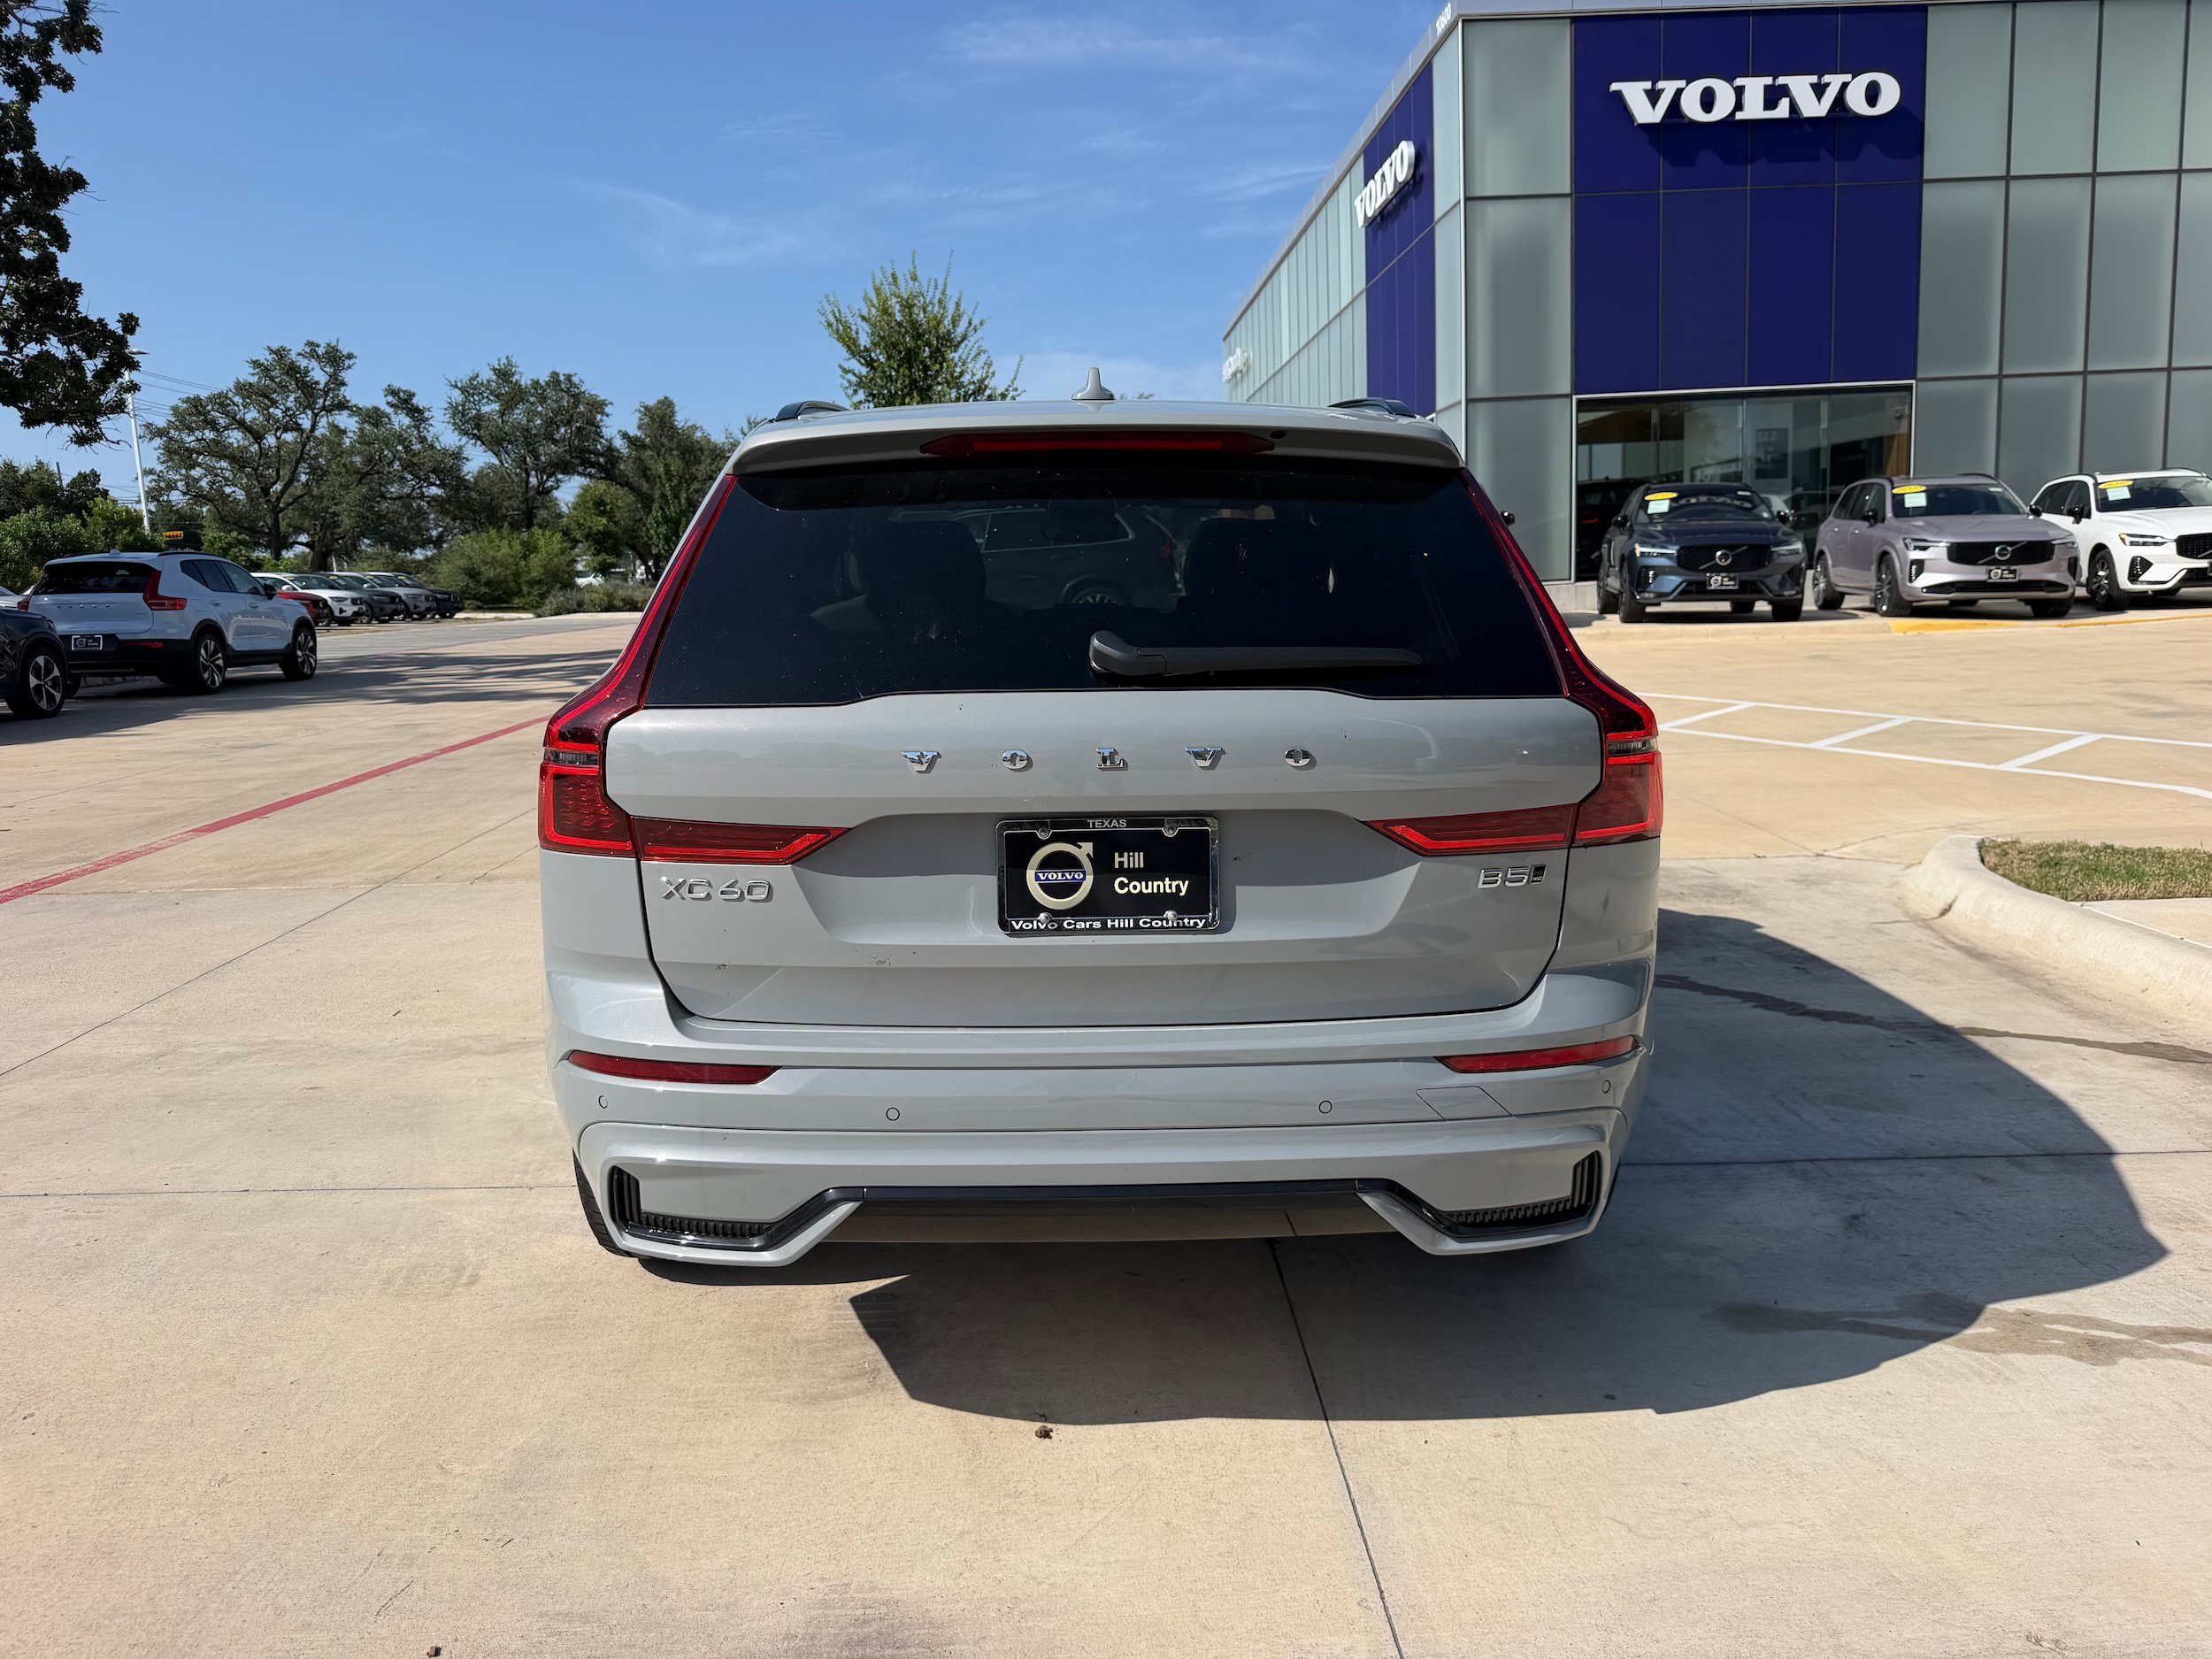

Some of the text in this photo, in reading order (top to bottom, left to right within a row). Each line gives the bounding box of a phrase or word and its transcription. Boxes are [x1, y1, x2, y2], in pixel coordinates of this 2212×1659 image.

[1609, 71, 1901, 126] VOLVO
[1354, 140, 1414, 228] VOLVO
[901, 746, 1312, 772] VOLVO
[1087, 818, 1127, 829] TEXAS
[1113, 851, 1145, 869] Hill
[1036, 871, 1084, 881] VOLVO
[1113, 876, 1190, 896] Country
[1477, 866, 1529, 888] B5
[660, 876, 771, 902] XC60
[1010, 917, 1207, 930] Volvo Cars Hill Country
